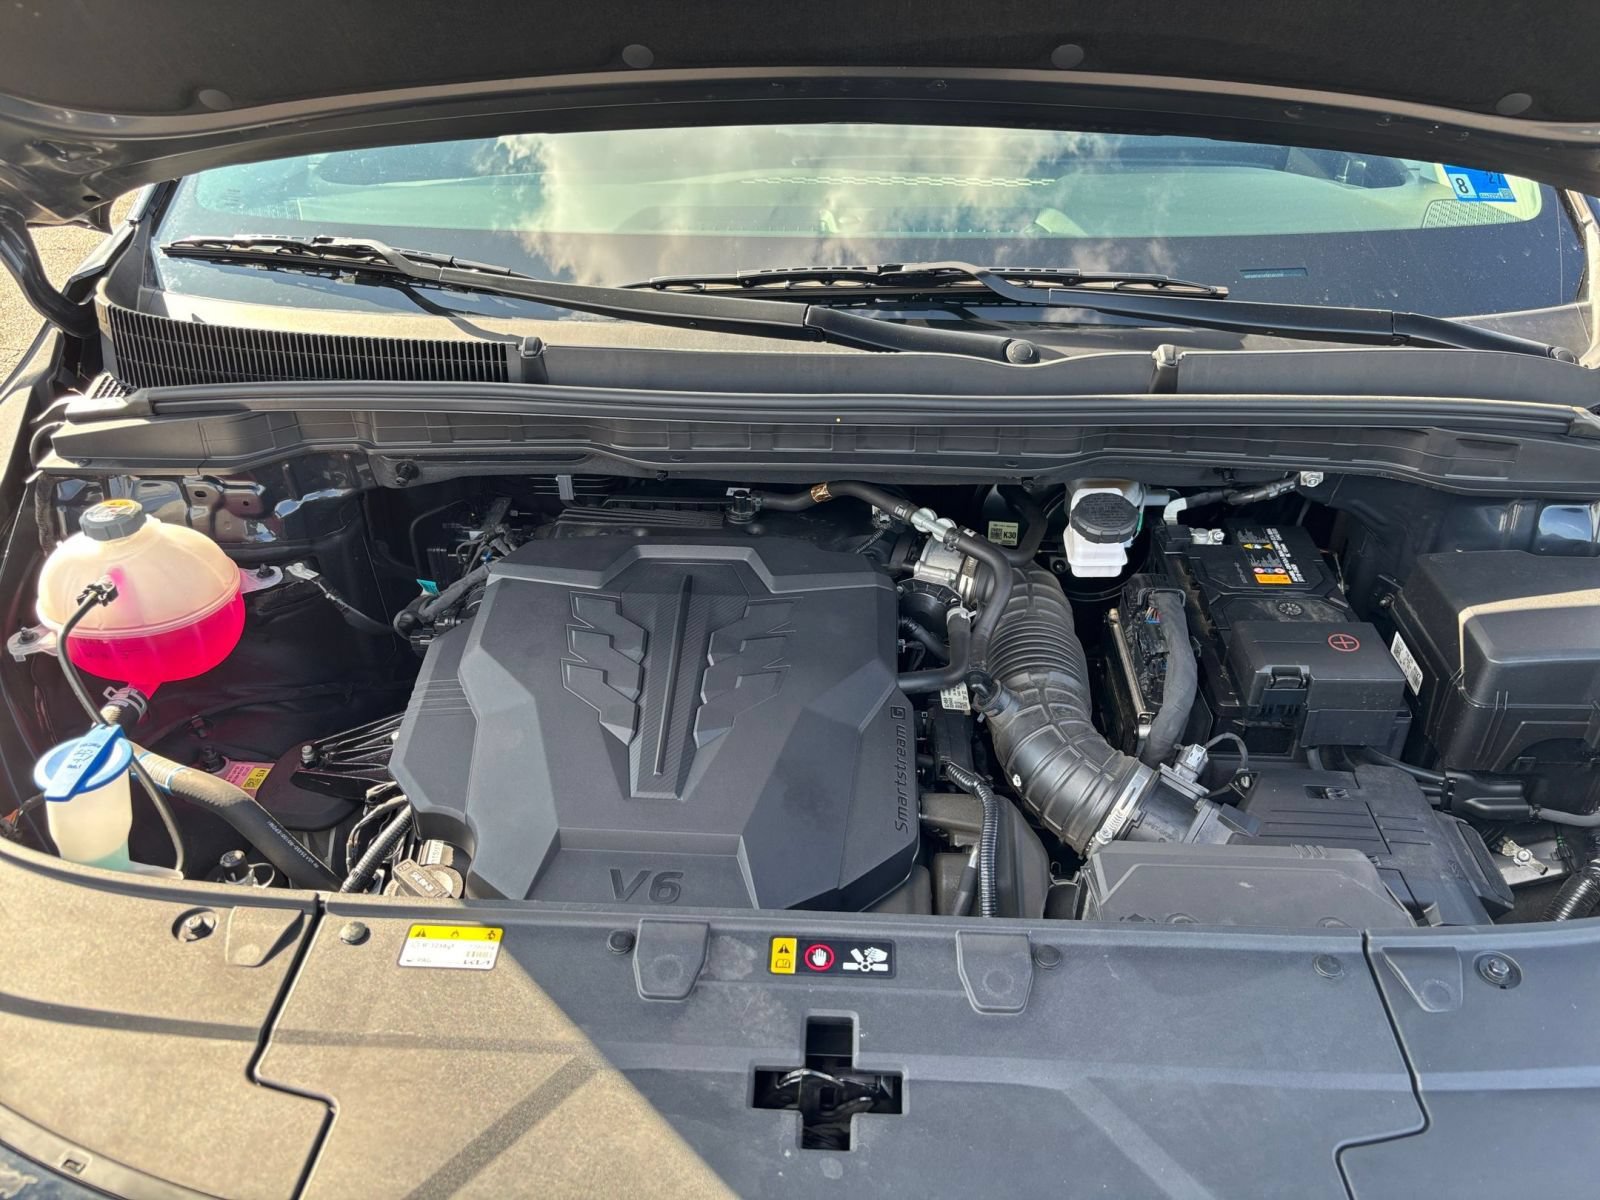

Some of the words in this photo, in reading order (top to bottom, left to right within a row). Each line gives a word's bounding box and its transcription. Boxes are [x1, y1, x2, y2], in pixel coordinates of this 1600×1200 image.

[1455, 177, 1470, 194] 8
[1003, 531, 1017, 539] K30
[894, 724, 908, 834] Smartstream
[610, 868, 683, 904] V6
